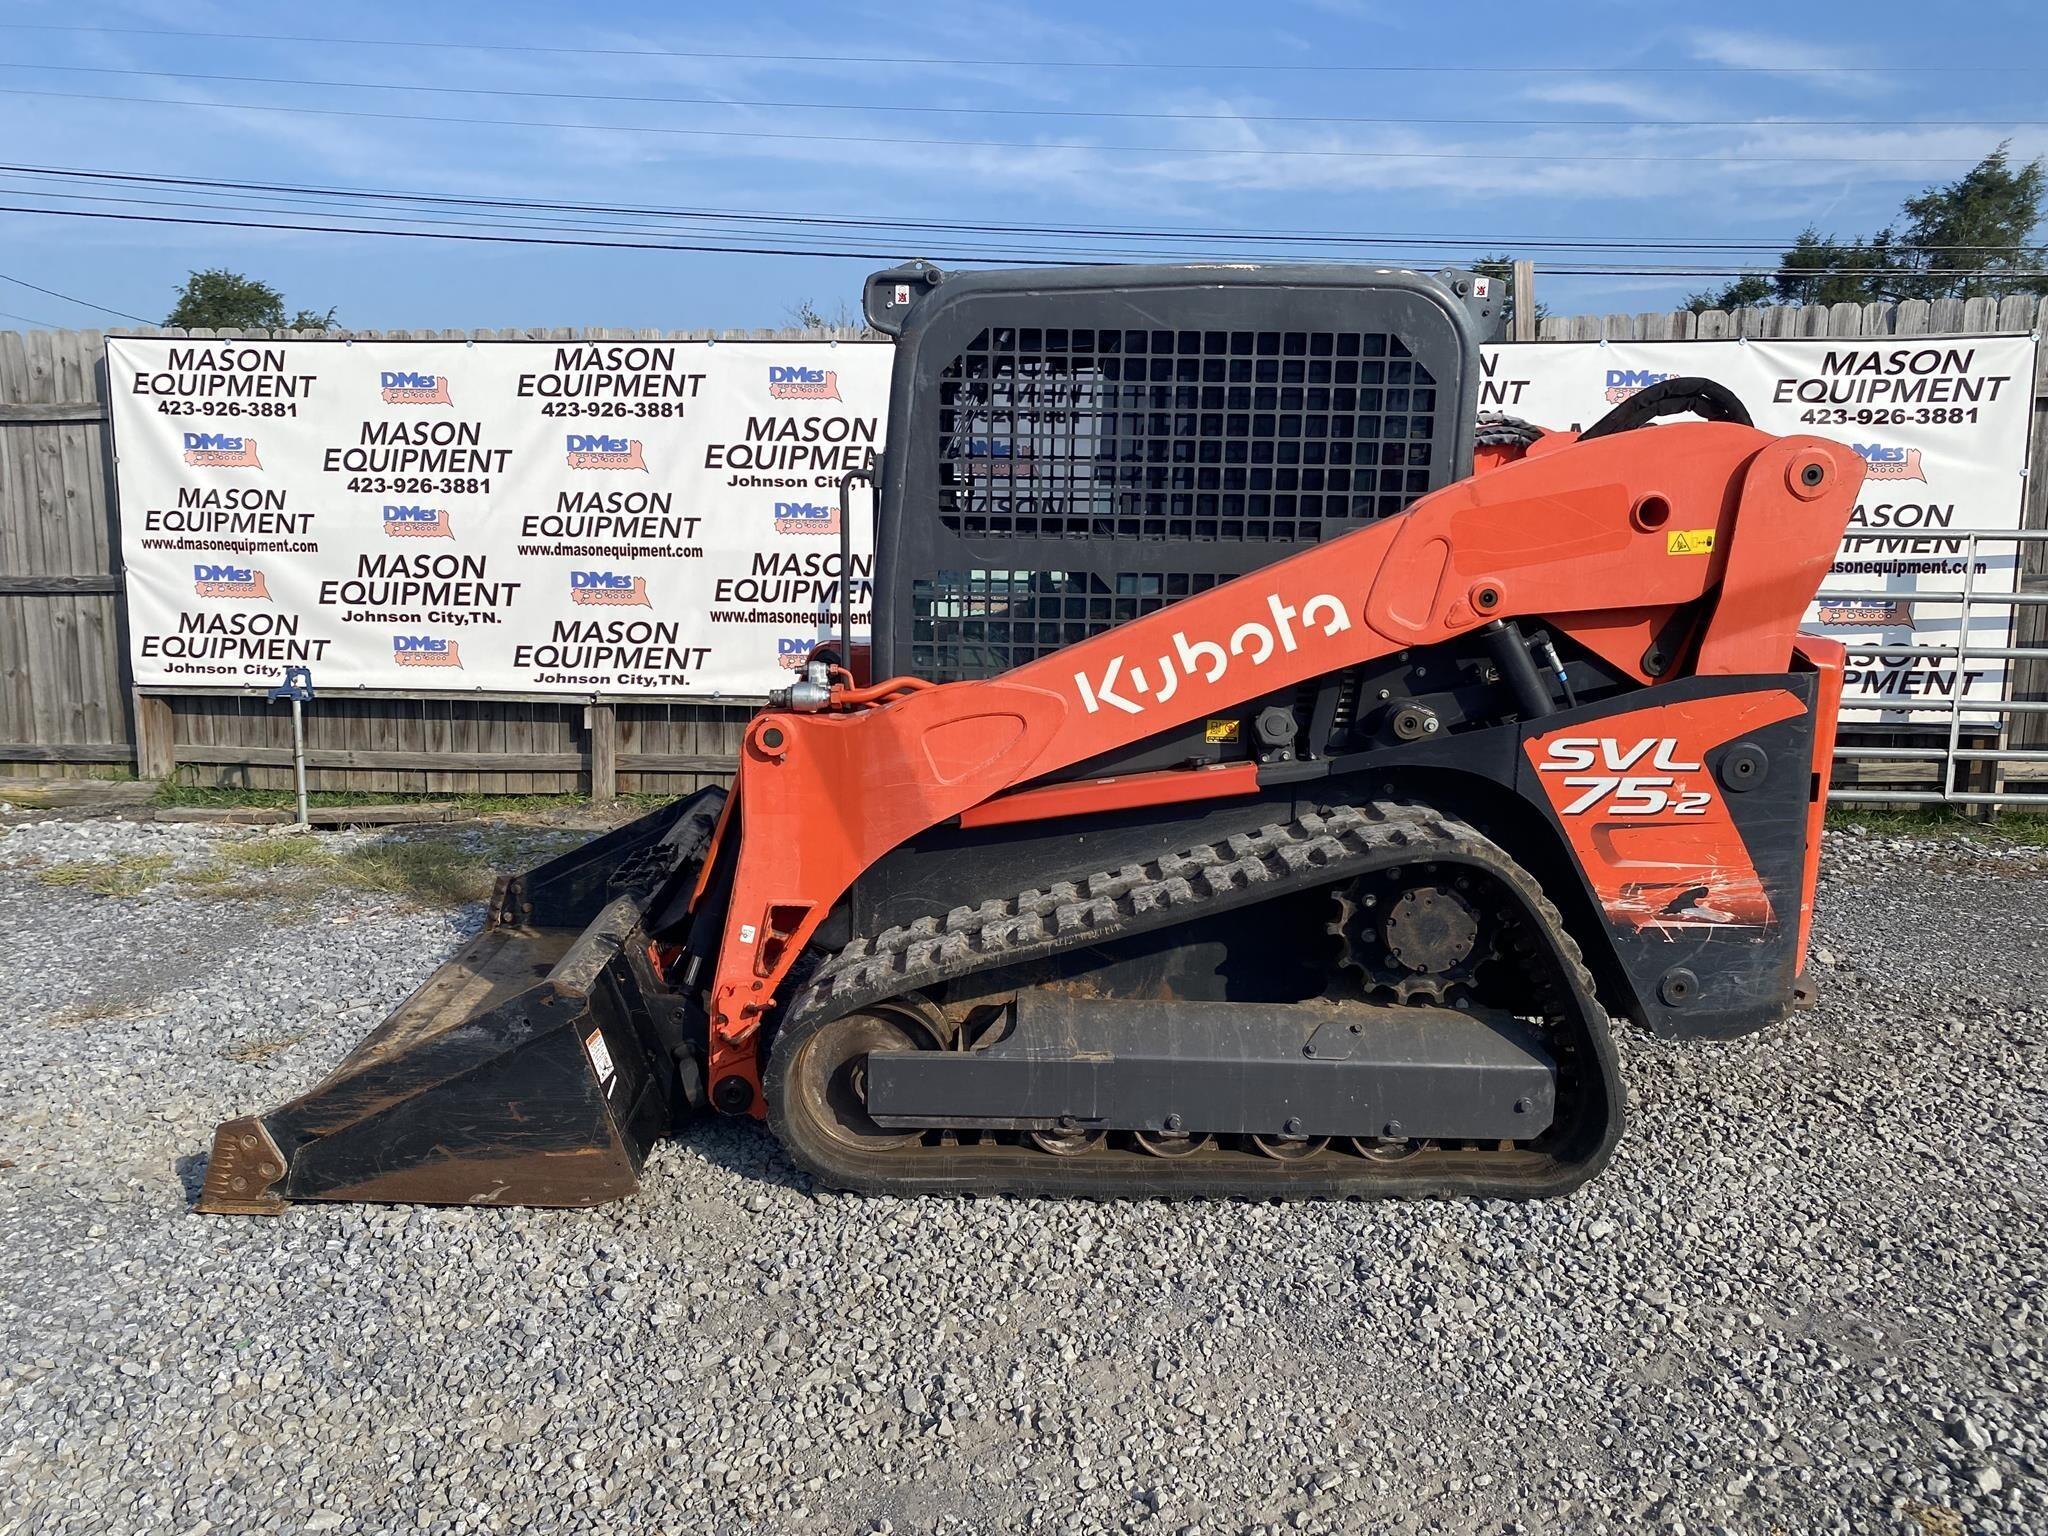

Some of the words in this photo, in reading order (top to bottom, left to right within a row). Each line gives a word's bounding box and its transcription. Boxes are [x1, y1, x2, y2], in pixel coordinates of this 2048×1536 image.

[169, 349, 285, 371] MASON
[555, 348, 674, 371] MASON
[1822, 349, 1975, 375] MASON
[133, 373, 316, 397] EQUIPMENT
[518, 374, 706, 397] EQUIPMENT
[1773, 377, 2010, 403] EQUIPMENT
[158, 401, 296, 417] 423-926-3881
[542, 402, 683, 417] 423-926-3881
[1801, 408, 1977, 424] 423-926-3881
[361, 422, 481, 445] MASON
[746, 417, 877, 442] MASON
[324, 448, 512, 472] EQUIPMENT
[703, 444, 876, 471] EQUIPME
[347, 478, 489, 493] 423-926-3881
[728, 475, 807, 487] Johnson
[178, 488, 286, 510] MASON
[557, 492, 672, 513] MASON
[146, 511, 314, 534] EQUIPMENT
[522, 516, 701, 538] EQUIPMENT
[1850, 503, 1955, 528] ASON
[142, 537, 318, 554] www.dmasonequipment.com
[518, 542, 702, 560] www.dmasonequipment.com
[358, 555, 486, 579] MASON
[319, 581, 521, 606] EQUIPMENT
[714, 578, 874, 604] EQUIPMEN
[179, 613, 298, 635] MASON
[342, 611, 421, 622] Johnson
[428, 612, 501, 626] City,TN.
[553, 621, 679, 644] MASON
[142, 636, 331, 660] EQUIPMENT
[514, 646, 711, 669] EQUIPMENT
[778, 638, 816, 654] DM
[1074, 594, 1351, 714] Kubota
[164, 663, 236, 673] Johnson
[533, 673, 619, 685] Johnson
[621, 673, 690, 687] City,TN.
[1539, 738, 1700, 769] SVL
[1561, 777, 1711, 813] 75-2
